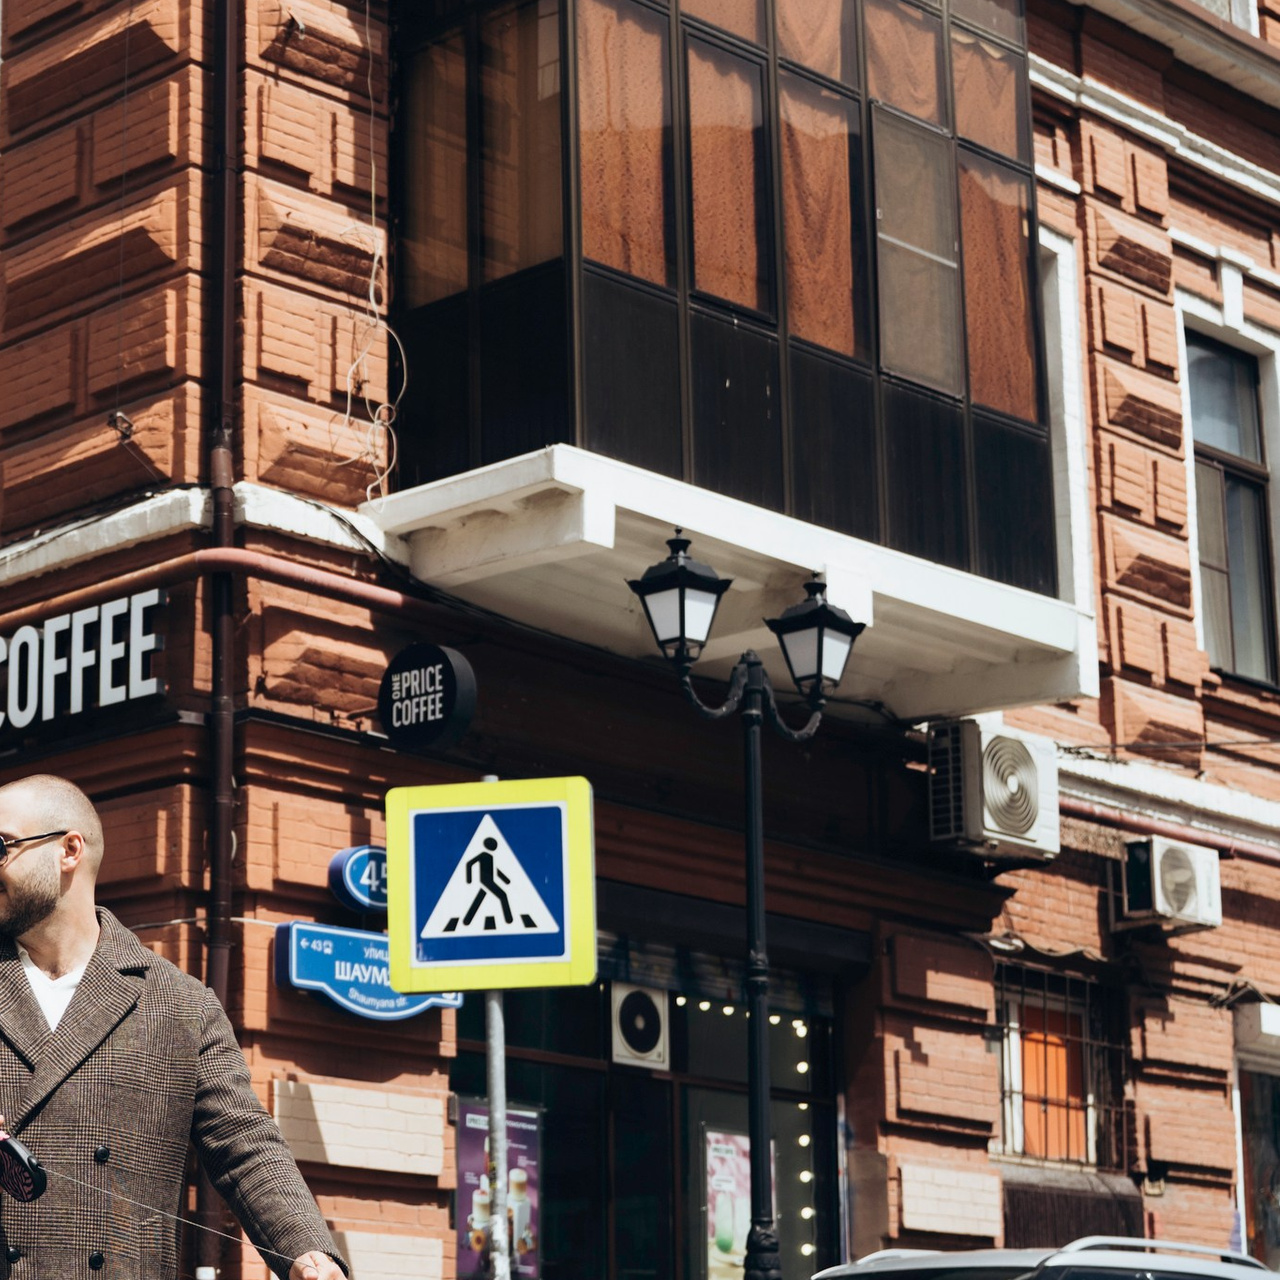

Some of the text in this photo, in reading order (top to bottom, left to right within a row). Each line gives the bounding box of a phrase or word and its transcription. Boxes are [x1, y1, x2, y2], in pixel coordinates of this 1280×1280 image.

[392, 664, 443, 700] ONE PRICE
[392, 692, 443, 728] COFFEE
[363, 946, 389, 963] УЛИЦ
[334, 960, 391, 987] ШАУМ
[348, 987, 395, 1009] Shaumyana
